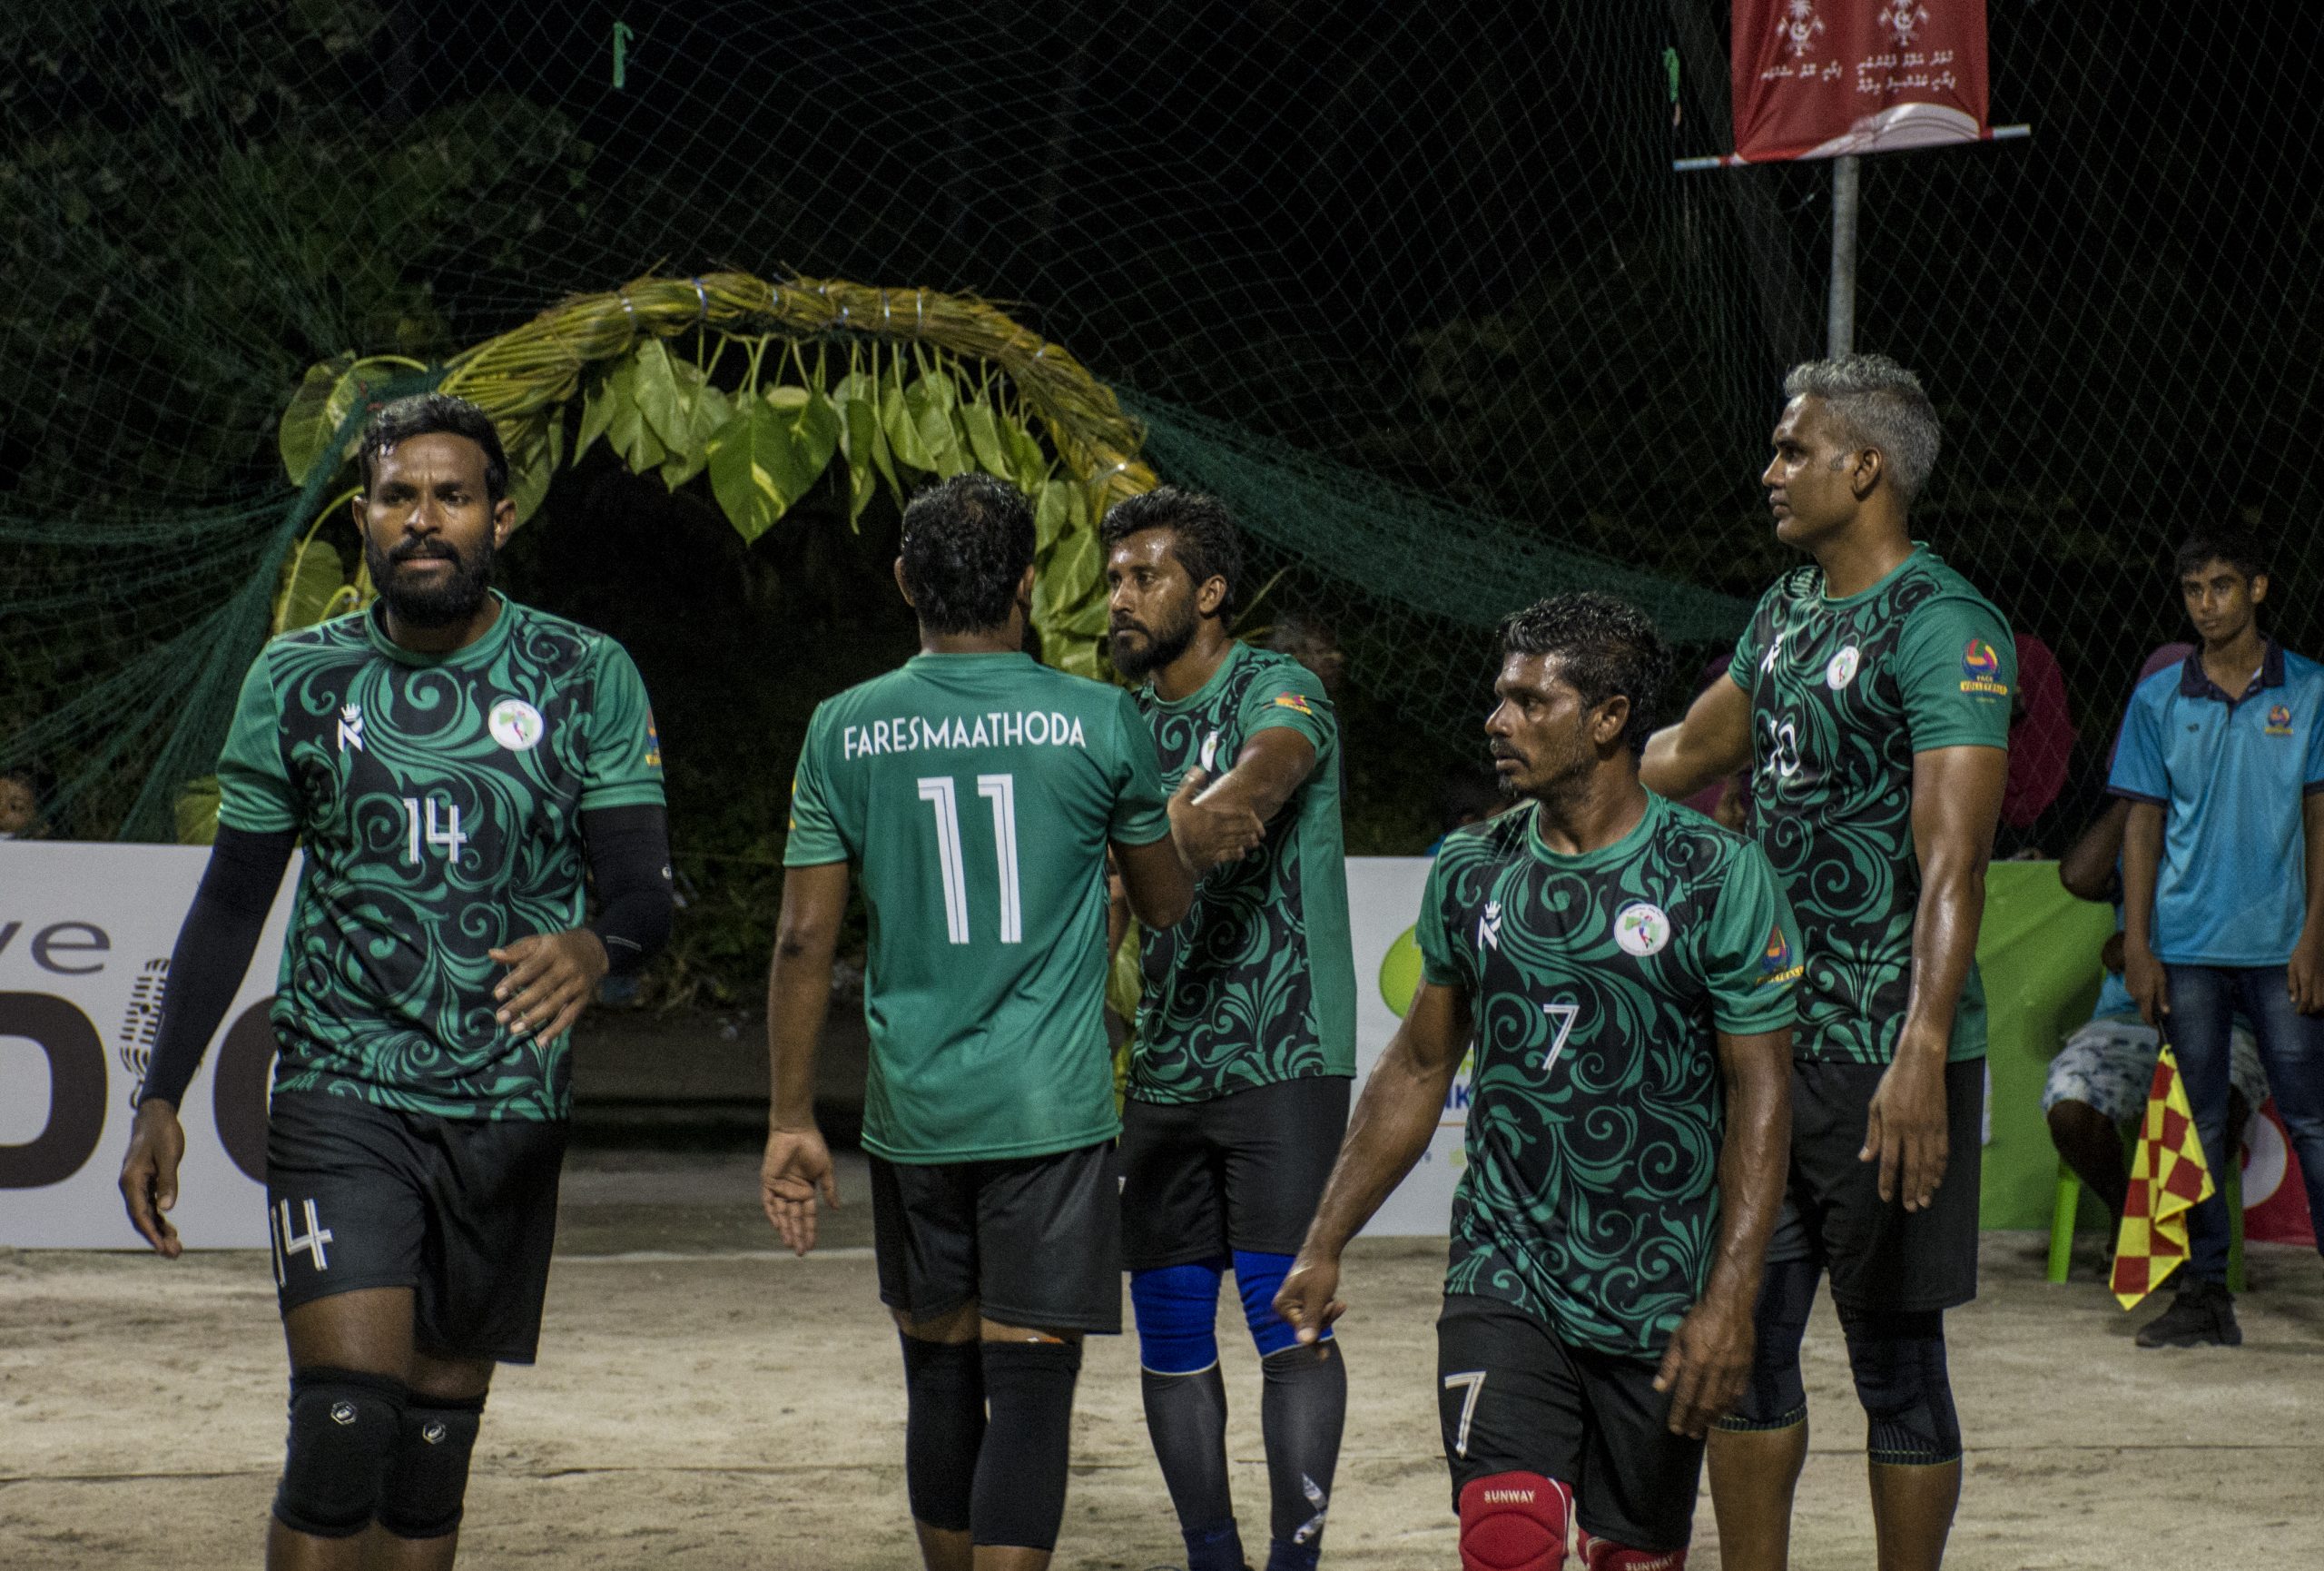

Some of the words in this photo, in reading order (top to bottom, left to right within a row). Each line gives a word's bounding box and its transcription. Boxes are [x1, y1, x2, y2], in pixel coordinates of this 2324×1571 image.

[842, 711, 1086, 760] FARESMAATHODA
[403, 797, 467, 864] 14
[917, 774, 1021, 944] 11
[1542, 1003, 1580, 1071] 7
[271, 1199, 332, 1288] 14
[1444, 1370, 1486, 1457] 7
[1483, 1489, 1536, 1504] SUNWAY
[1625, 1554, 1673, 1571] SUNWAY
